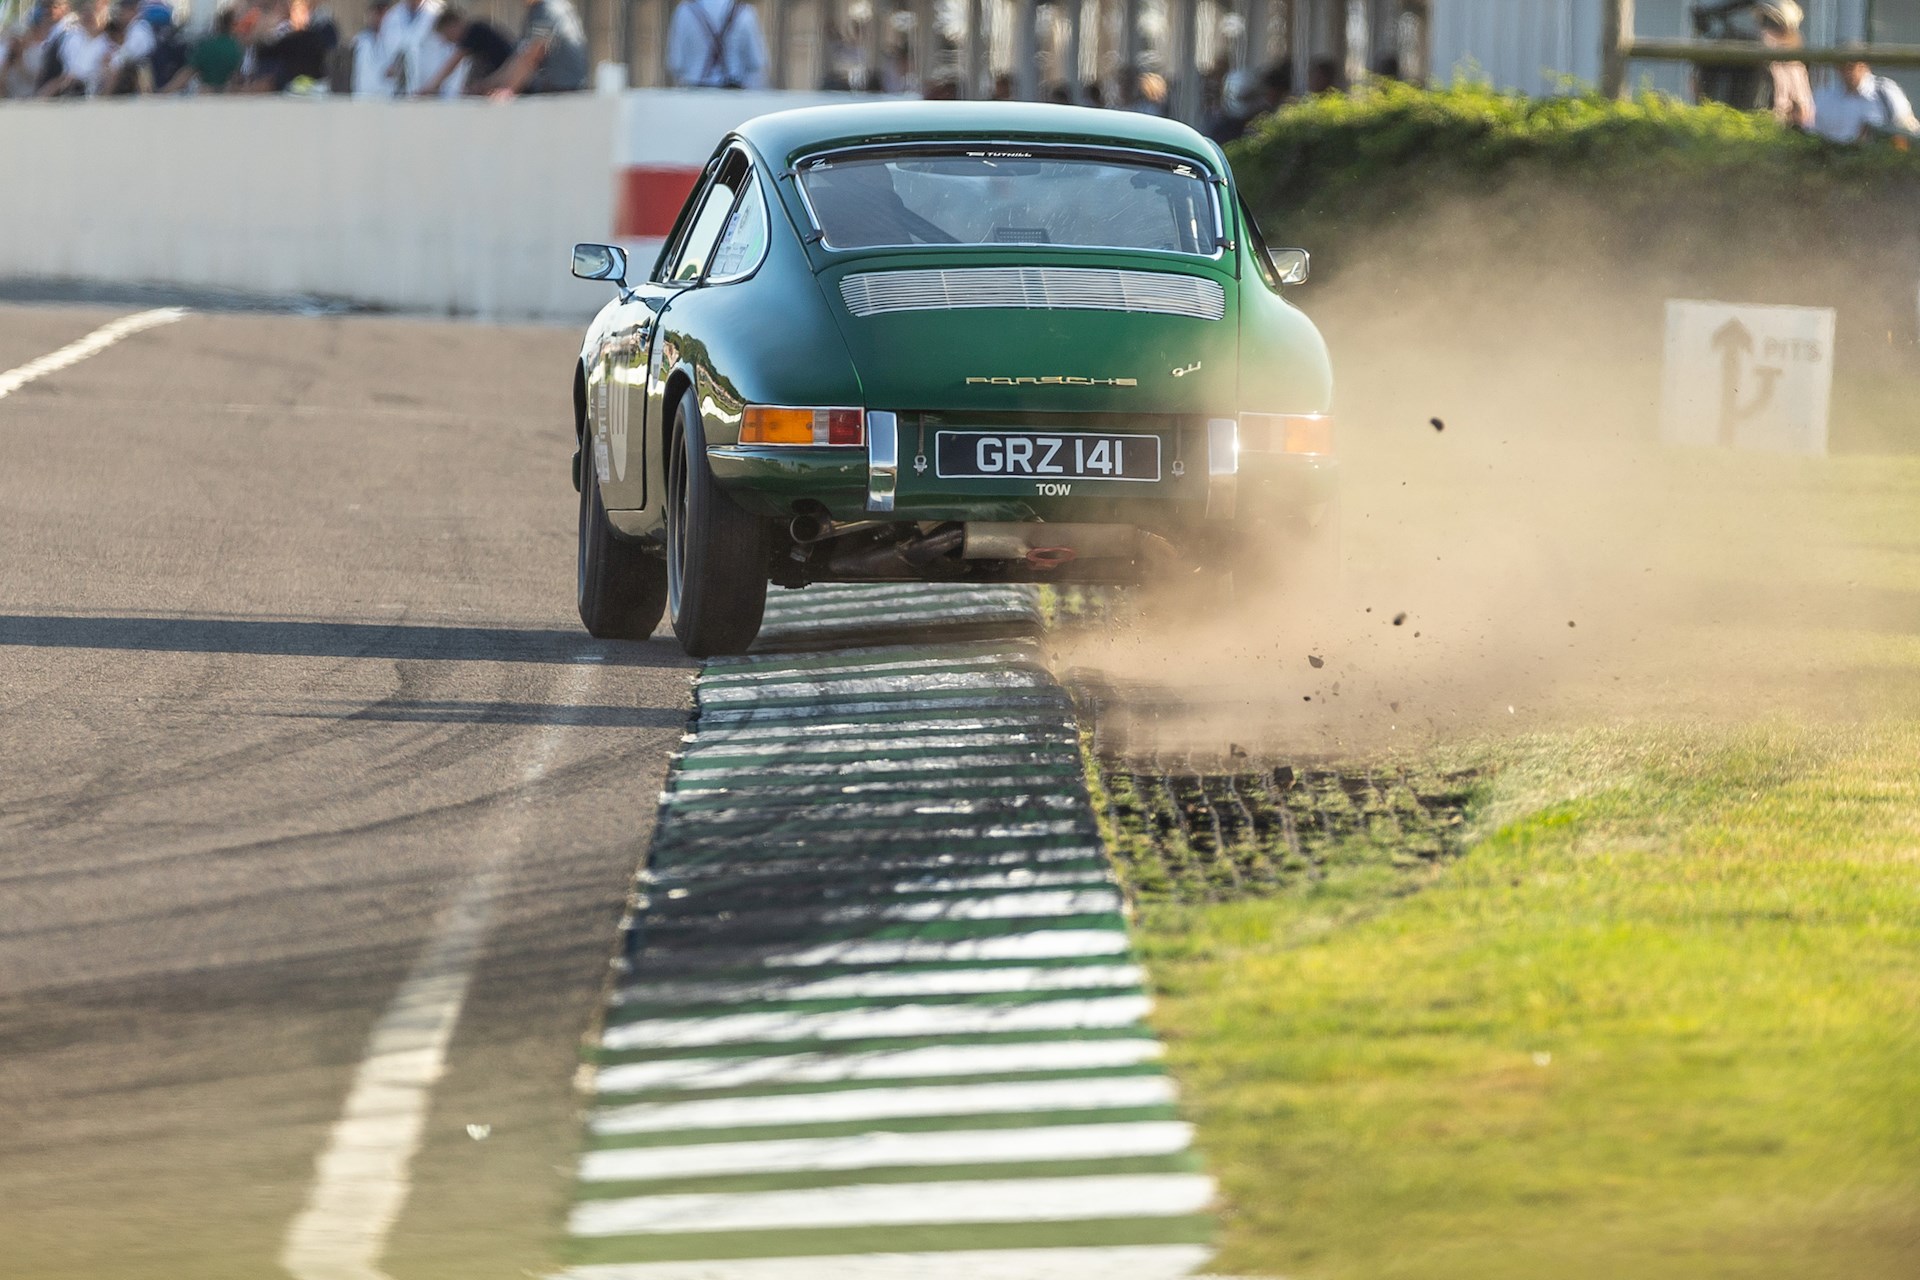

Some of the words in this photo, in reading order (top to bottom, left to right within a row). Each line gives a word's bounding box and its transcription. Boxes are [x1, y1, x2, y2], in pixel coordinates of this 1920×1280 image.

[1762, 336, 1822, 363] PITS
[966, 376, 1137, 386] PORSCHE
[976, 437, 1064, 474] GRZ
[1075, 438, 1123, 475] 141
[1036, 483, 1071, 496] TOW
